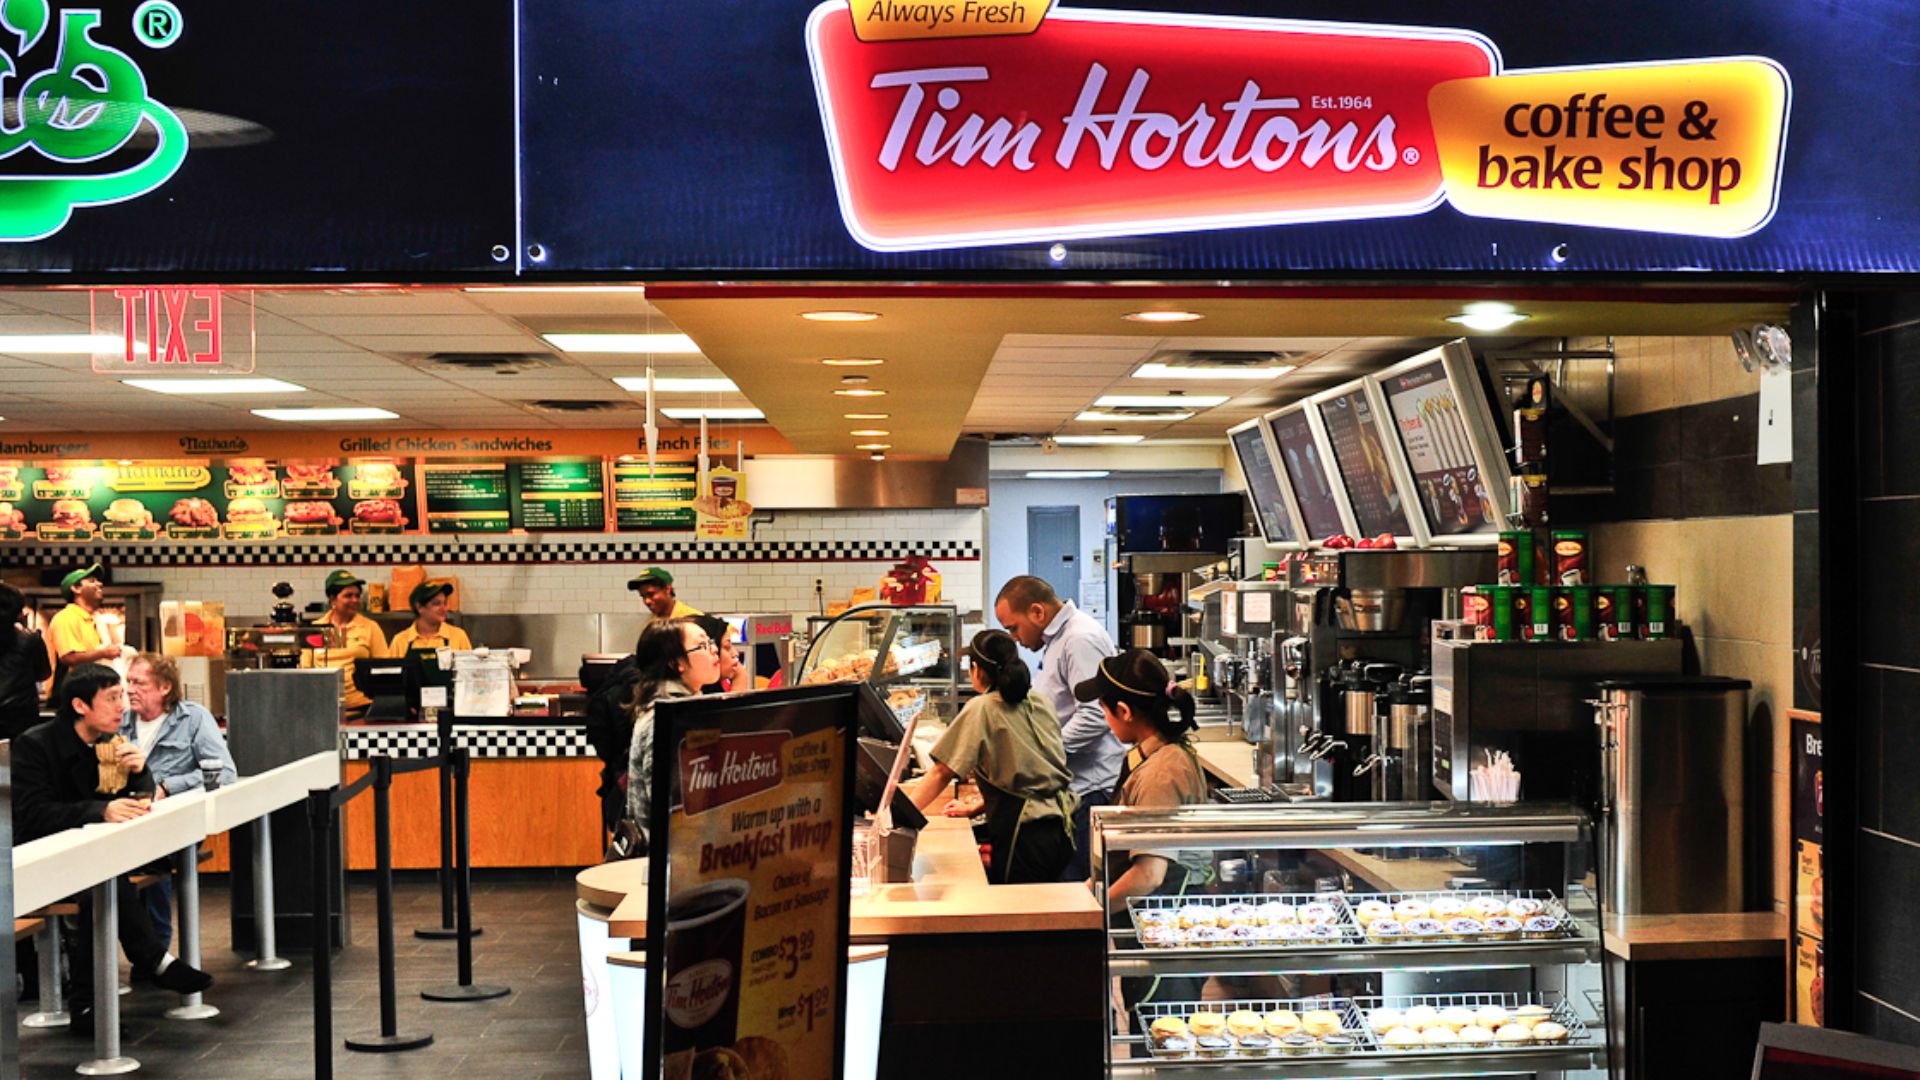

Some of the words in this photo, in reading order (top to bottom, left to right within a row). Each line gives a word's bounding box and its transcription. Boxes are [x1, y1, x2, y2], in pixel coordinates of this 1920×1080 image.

[866, 0, 956, 29] Always
[961, 0, 1025, 23] Fresh
[869, 66, 1041, 172] Tim
[1053, 61, 1398, 172] Hortons
[1311, 95, 1373, 110] Est.1964
[1503, 93, 1665, 140] coffee
[1677, 99, 1719, 141] &
[1476, 144, 1604, 190] bake
[1617, 145, 1742, 206] shop
[339, 437, 390, 452] Grilled
[396, 437, 456, 452] Chicken
[460, 437, 553, 451] Sandwiches
[638, 436, 690, 450] Fench
[693, 436, 729, 450] Fies
[688, 755, 719, 793] Tim
[719, 750, 778, 786] Hortons
[731, 809, 768, 832] Warm
[769, 805, 785, 829] up
[786, 796, 811, 820] with
[813, 797, 821, 814] a
[699, 827, 785, 873] Breakfast
[789, 820, 833, 853] Wrap
